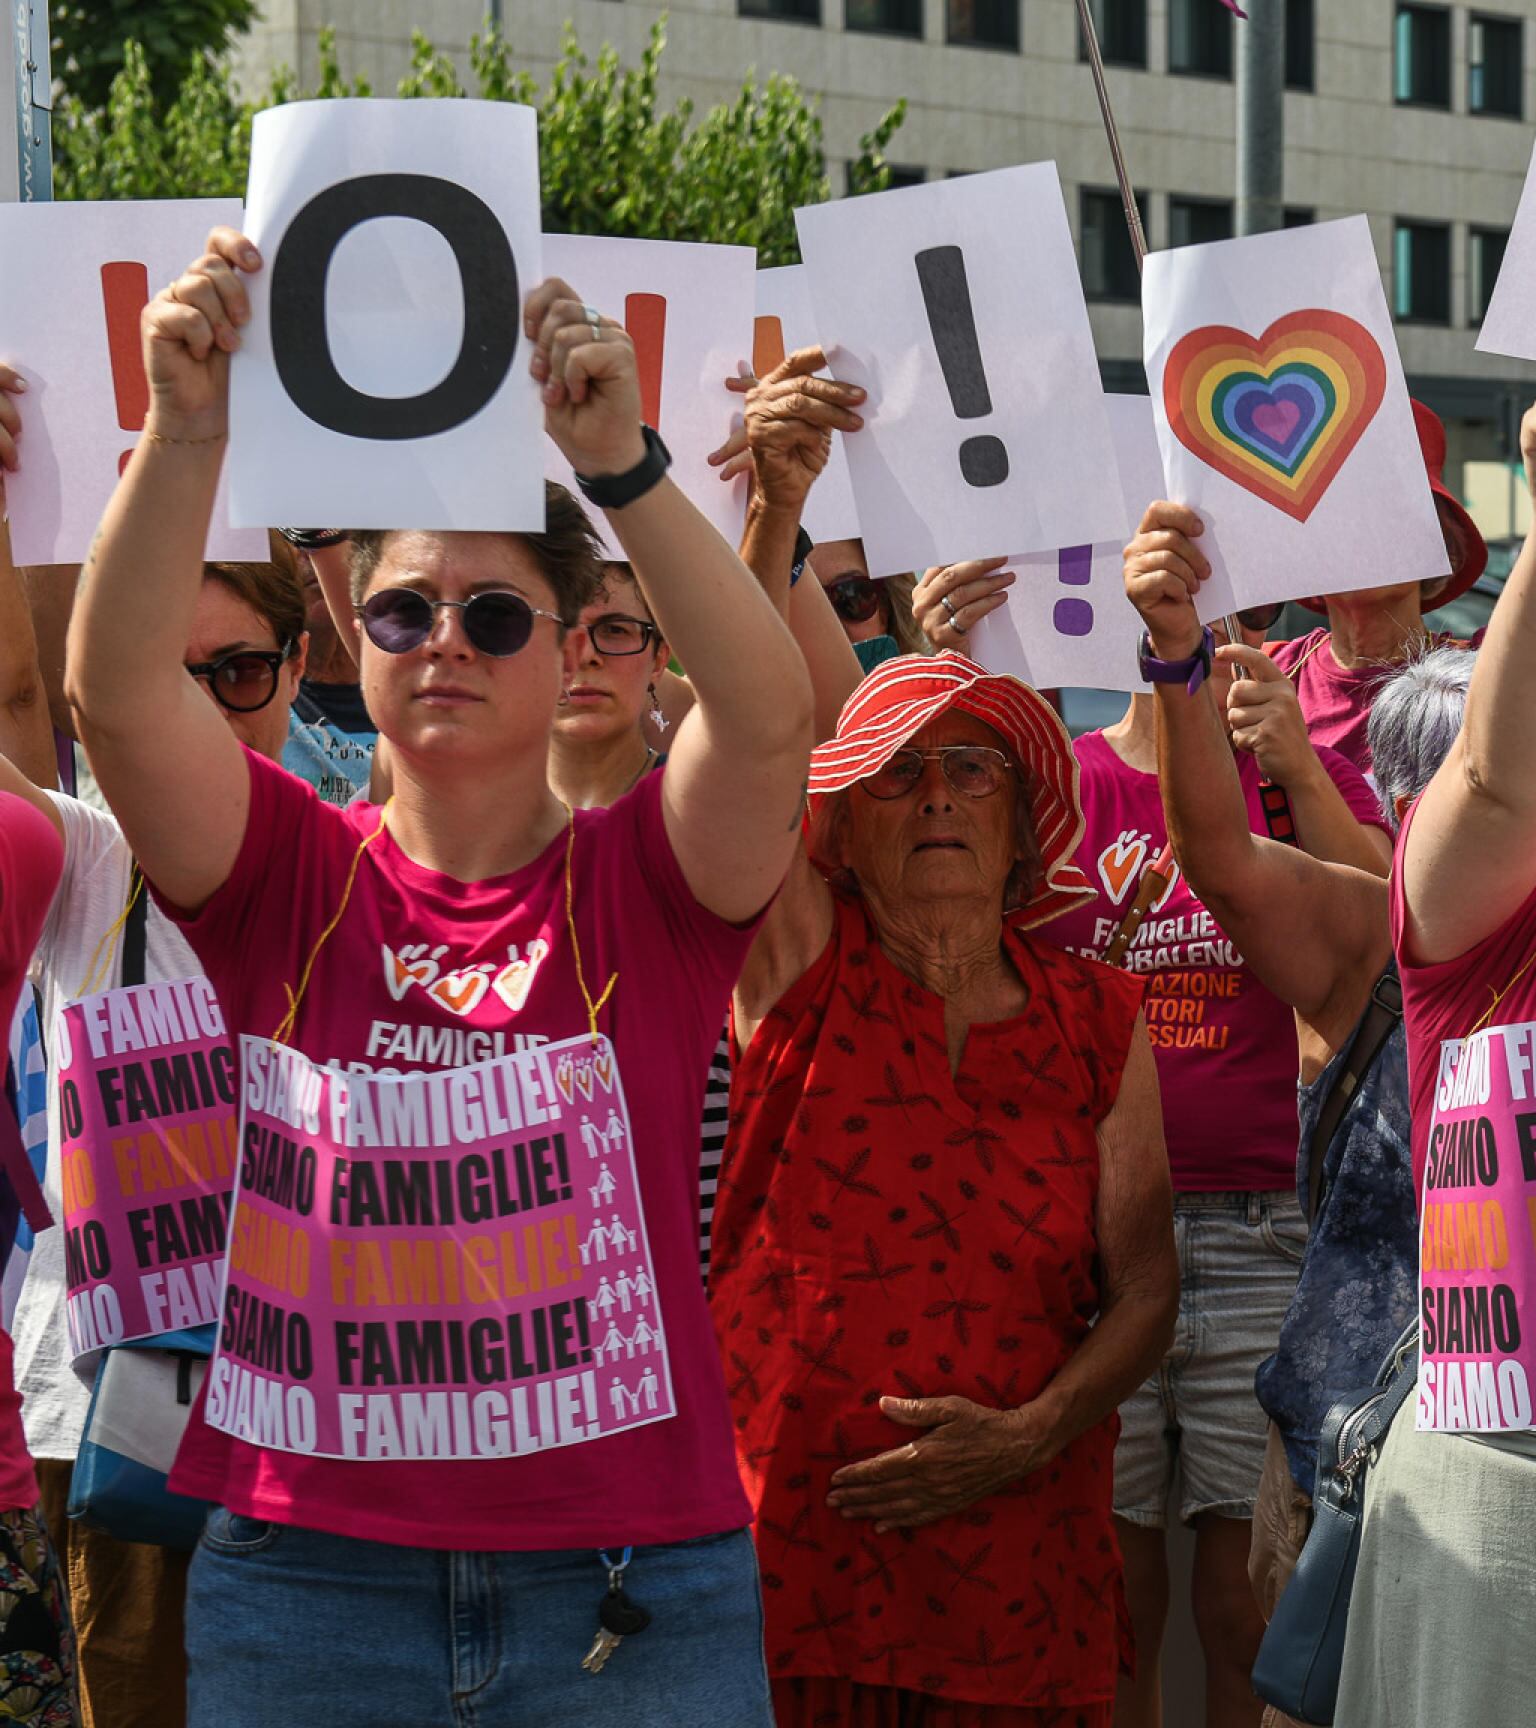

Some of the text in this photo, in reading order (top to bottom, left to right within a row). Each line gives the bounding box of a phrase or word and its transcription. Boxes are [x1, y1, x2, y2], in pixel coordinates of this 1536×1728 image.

[269, 172, 521, 441] O
[82, 975, 227, 1060] FAMIG
[1145, 998, 1206, 1024] TORI
[1146, 972, 1243, 997] AZIONE
[96, 1046, 235, 1128] FAMIG
[245, 1042, 562, 1147] SIAMO FAMIGLIE!
[1439, 1034, 1491, 1113] SIAMO
[241, 1122, 573, 1227] SIAMO FAMIGLIE!
[1427, 1116, 1498, 1190] SIAMO
[231, 1202, 583, 1306] SIAMO FAMIGLIE!
[1421, 1198, 1509, 1273] SIAMO
[221, 1284, 593, 1387] SIAMO FAMIGLIE!
[1421, 1284, 1521, 1355] SIAMO
[207, 1357, 601, 1458] SIAMO FAMIGLIE!
[1418, 1359, 1532, 1429] SIAMO
